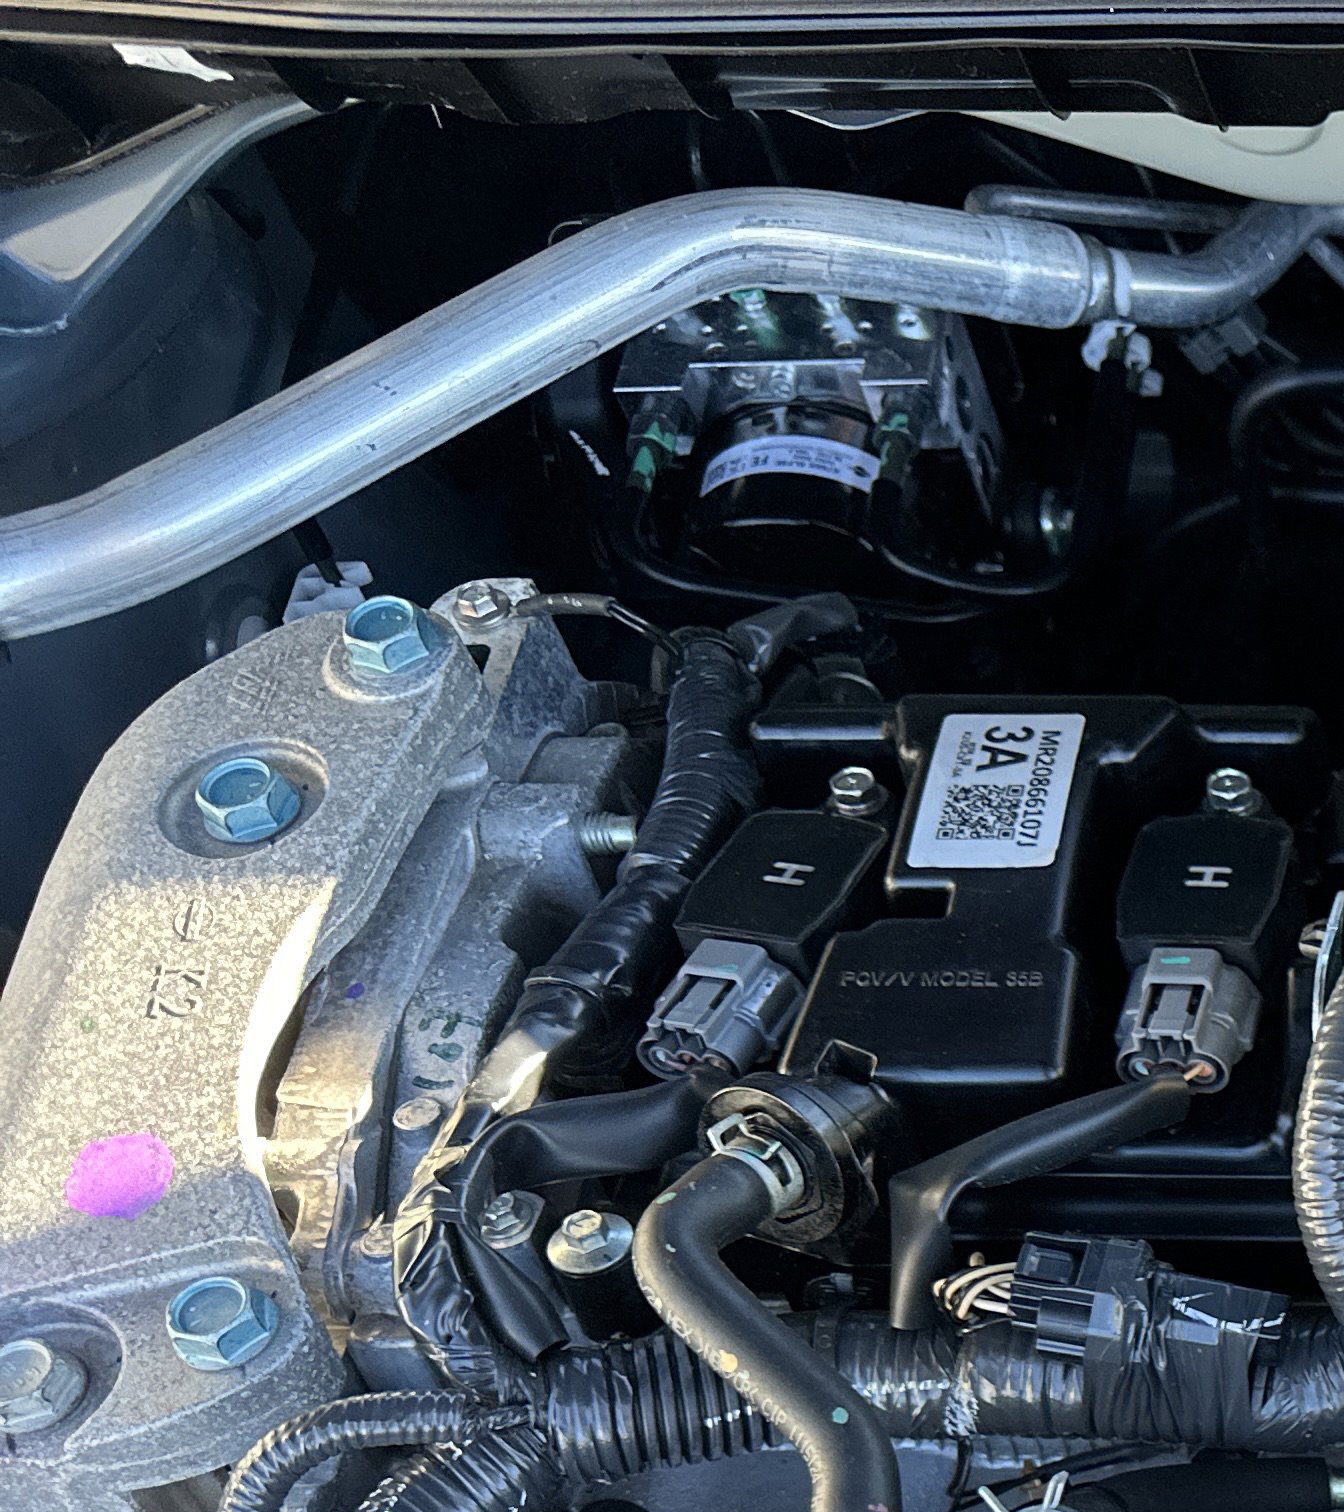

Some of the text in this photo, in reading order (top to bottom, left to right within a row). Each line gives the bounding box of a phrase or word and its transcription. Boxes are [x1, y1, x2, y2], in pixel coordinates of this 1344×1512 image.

[975, 725, 1035, 772] 3A
[1017, 729, 1063, 848] MR20866107J
[763, 861, 815, 886] H
[1183, 865, 1233, 888] H
[920, 971, 998, 988] MODEL
